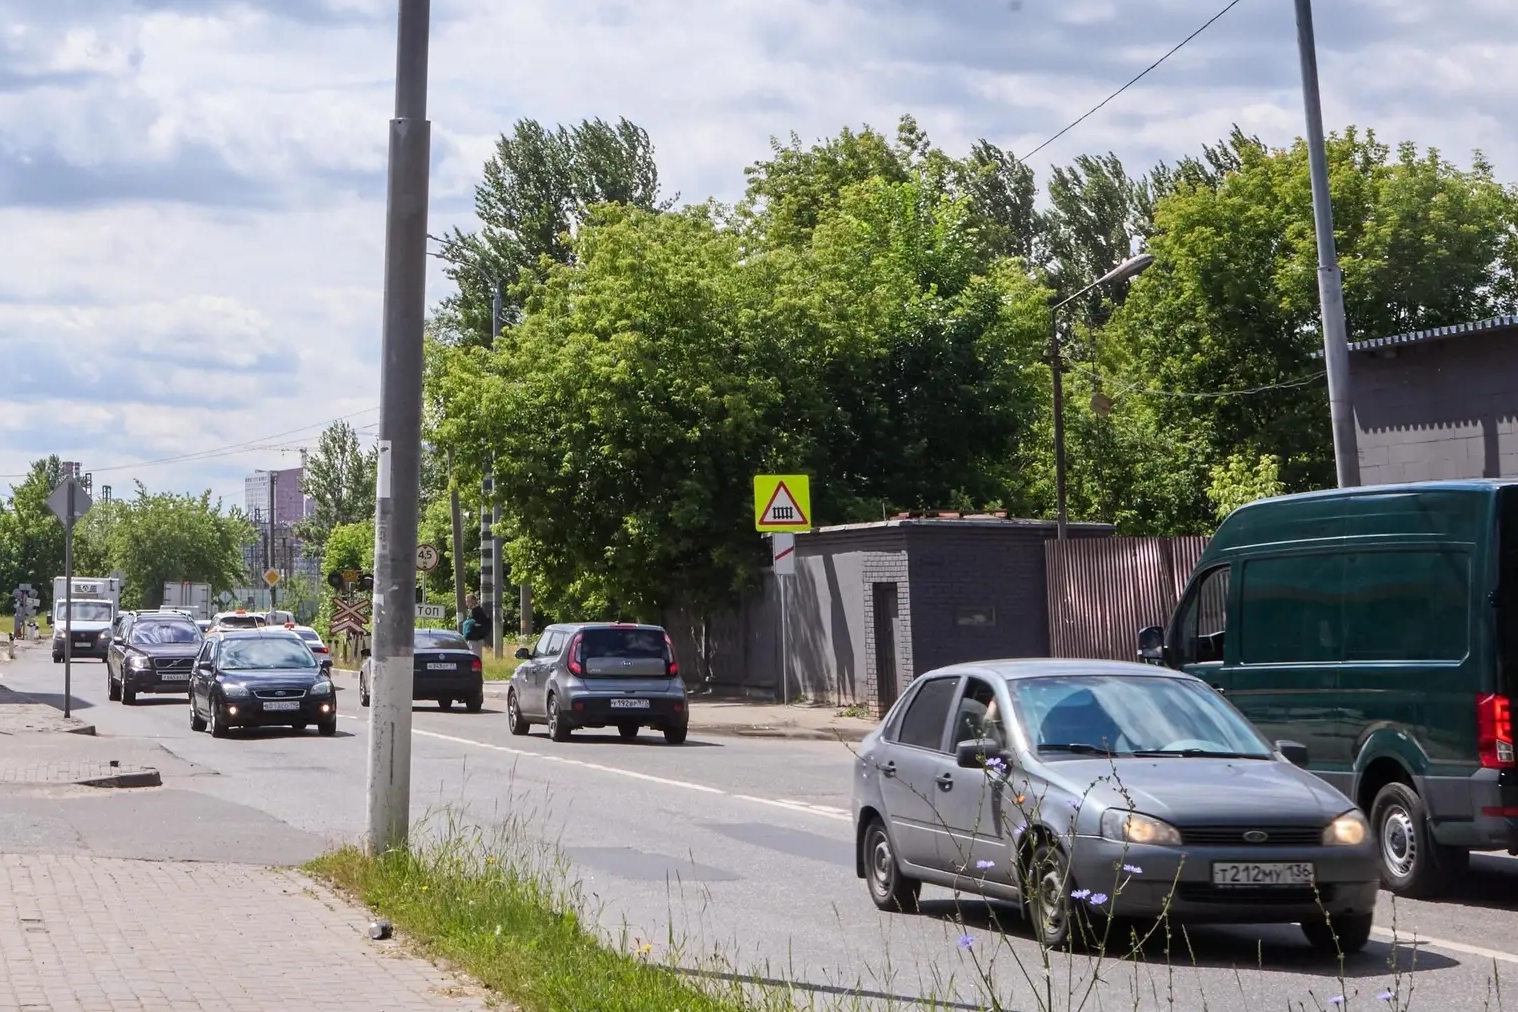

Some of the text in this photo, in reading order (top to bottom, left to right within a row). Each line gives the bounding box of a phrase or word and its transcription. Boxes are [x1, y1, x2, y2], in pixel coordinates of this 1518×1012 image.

[417, 550, 433, 561] 4,5
[417, 606, 440, 616] ТОП
[1219, 865, 1282, 882] Т212МУ
[1286, 864, 1310, 877] 136
